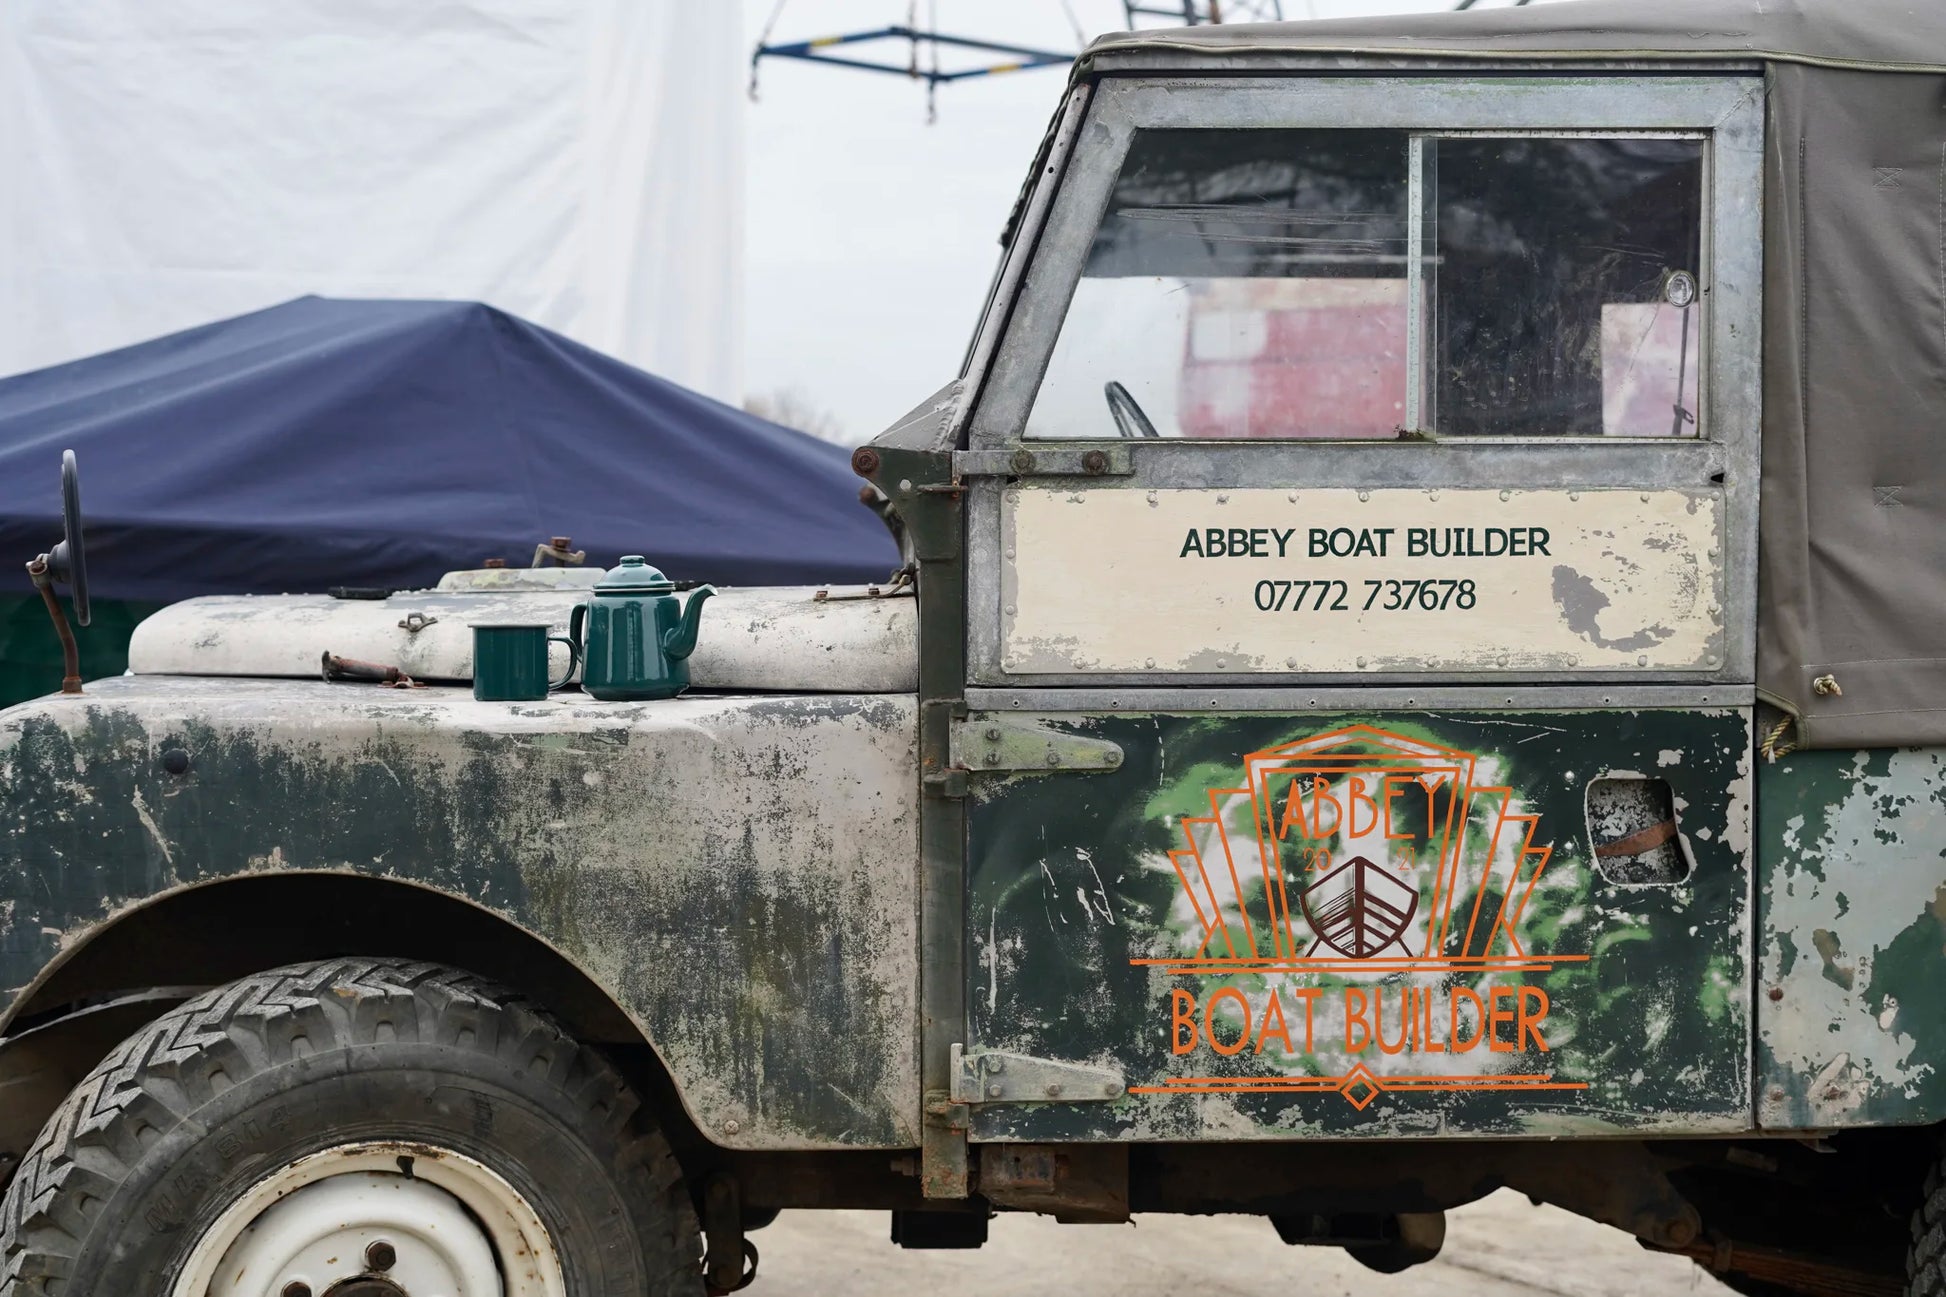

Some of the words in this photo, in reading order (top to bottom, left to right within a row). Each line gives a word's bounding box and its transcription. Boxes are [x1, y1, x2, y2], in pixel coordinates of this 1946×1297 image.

[1179, 528, 1296, 558] ABBEY
[1308, 527, 1395, 558] BOAT
[1407, 527, 1552, 557] BUILDER
[1254, 579, 1349, 612] 07772
[1362, 578, 1477, 611] 737678
[1279, 775, 1447, 840] ABBEY
[1303, 847, 1332, 872] 20
[1396, 846, 1416, 871] 21
[1172, 986, 1323, 1056] BOAT
[1345, 985, 1550, 1055] BUILDER
